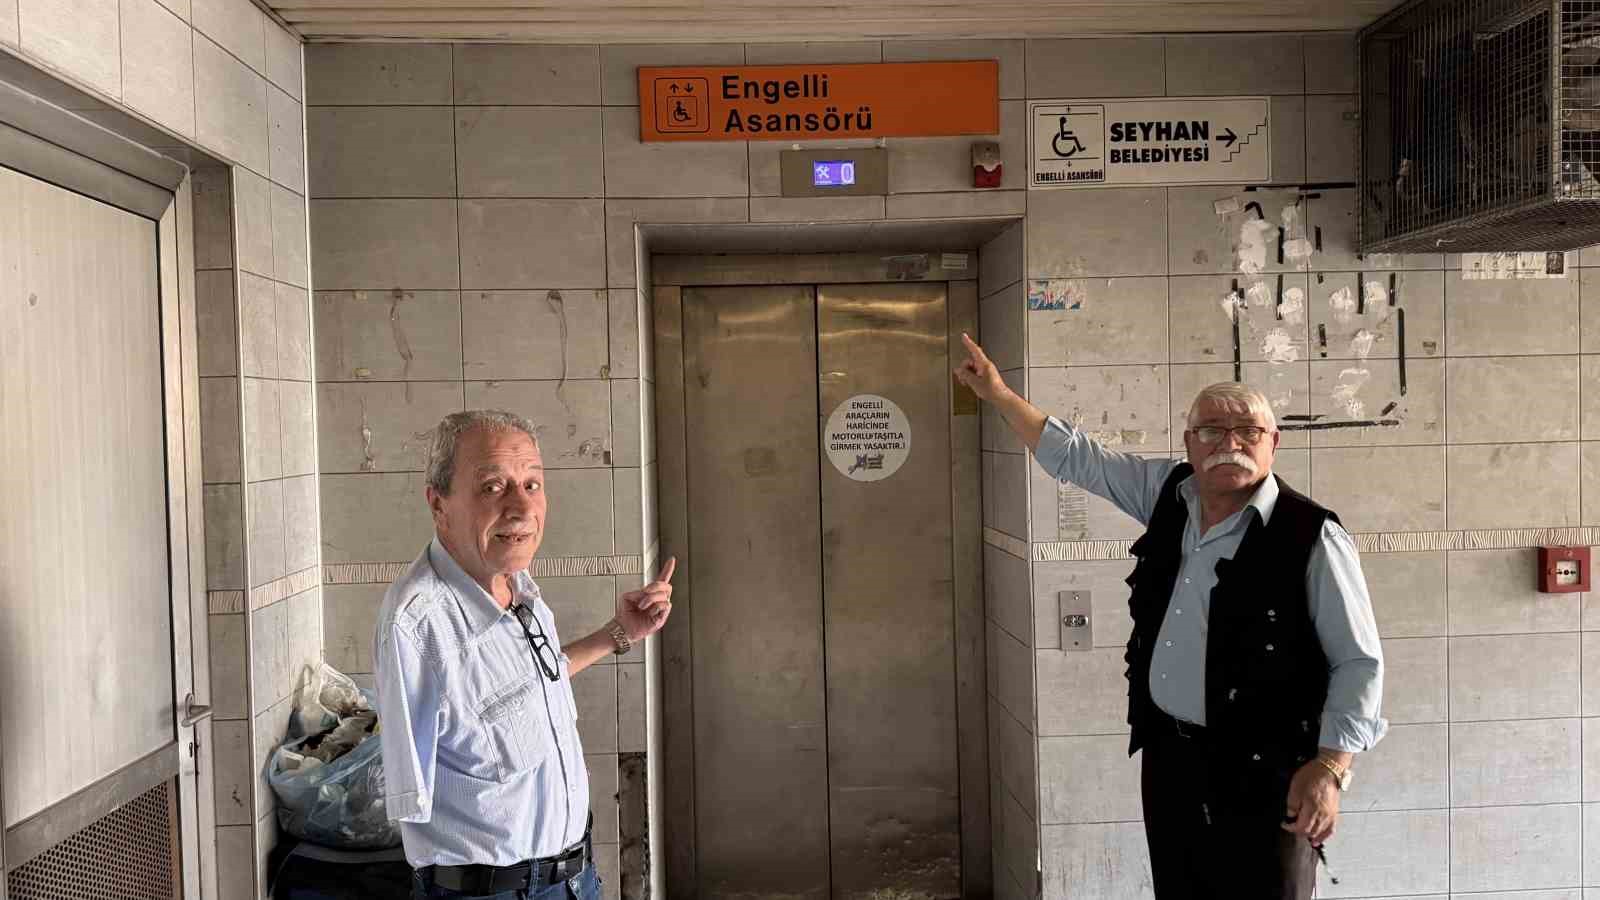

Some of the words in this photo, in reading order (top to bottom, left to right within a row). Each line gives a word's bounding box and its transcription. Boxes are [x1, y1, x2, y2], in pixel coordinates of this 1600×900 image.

[722, 74, 828, 103] Engelli
[725, 107, 873, 132] Asansörü
[1110, 121, 1209, 142] SEYHAN
[1110, 144, 1209, 163] BELEDİYESİ
[841, 163, 854, 183] 0
[1036, 170, 1065, 181] ENGELLİ
[1067, 169, 1103, 180] ASANSÖRÜ
[852, 400, 883, 409] ENGELLİ
[846, 412, 889, 420] ARAÇLARIN
[847, 421, 889, 430] HARİCİNDE
[830, 442, 861, 451] GİRMEK
